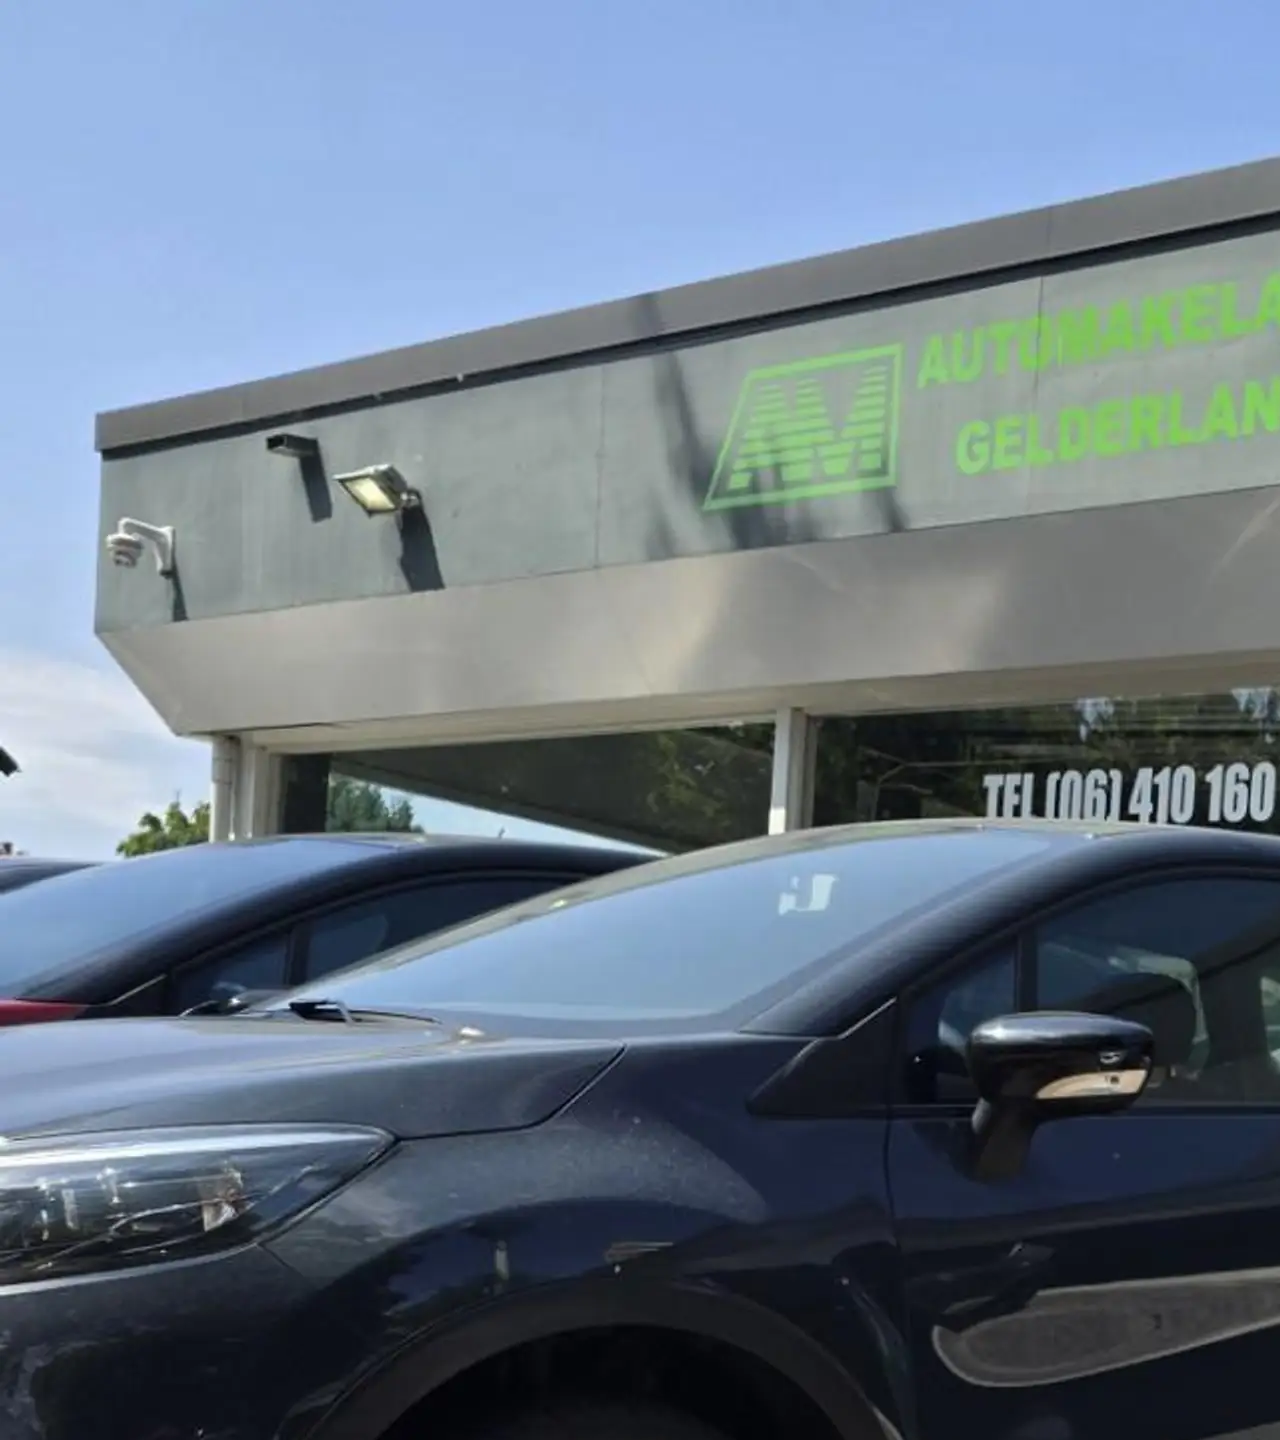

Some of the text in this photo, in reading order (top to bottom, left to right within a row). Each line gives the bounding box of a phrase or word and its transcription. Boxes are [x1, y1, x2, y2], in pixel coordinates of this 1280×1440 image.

[982, 772, 1035, 818] TEL
[1045, 768, 1124, 822] (06)
[1128, 765, 1196, 824] 410
[1204, 760, 1276, 823] 160
